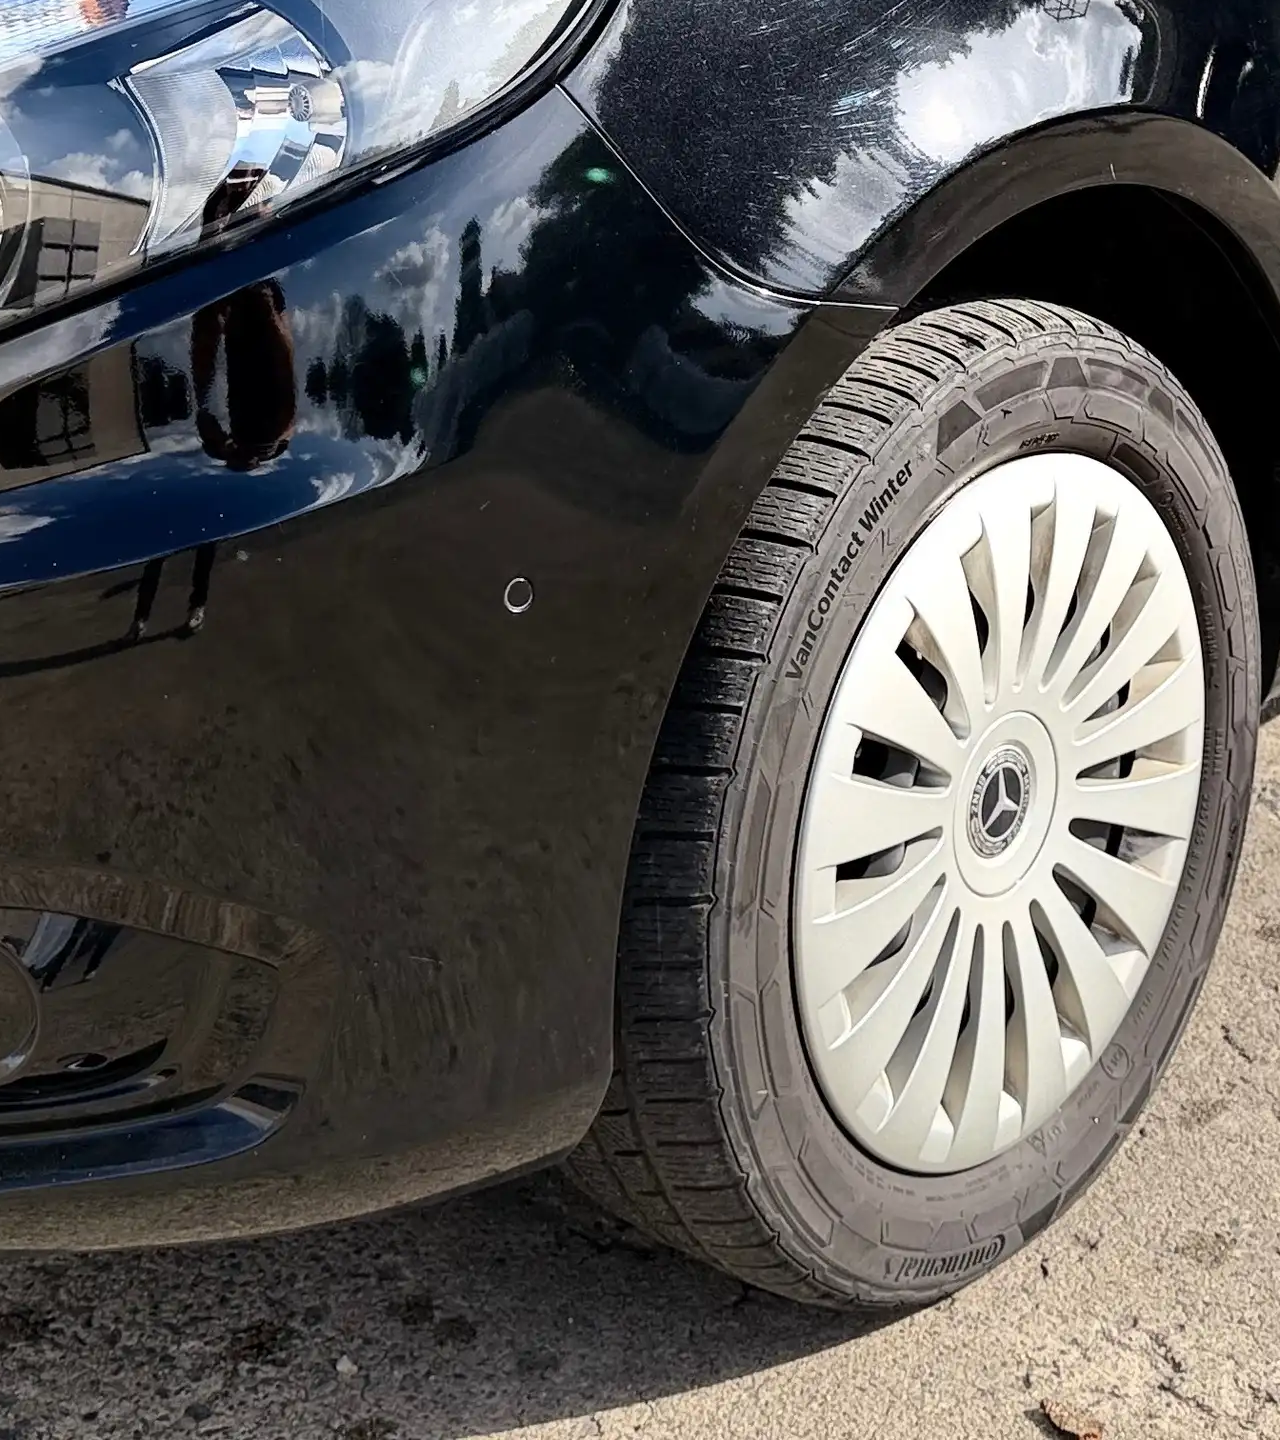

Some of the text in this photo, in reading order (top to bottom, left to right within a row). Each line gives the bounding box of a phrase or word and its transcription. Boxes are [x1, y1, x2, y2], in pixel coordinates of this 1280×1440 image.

[784, 458, 914, 681] VanContact Winter
[894, 1234, 1006, 1282] Continental
